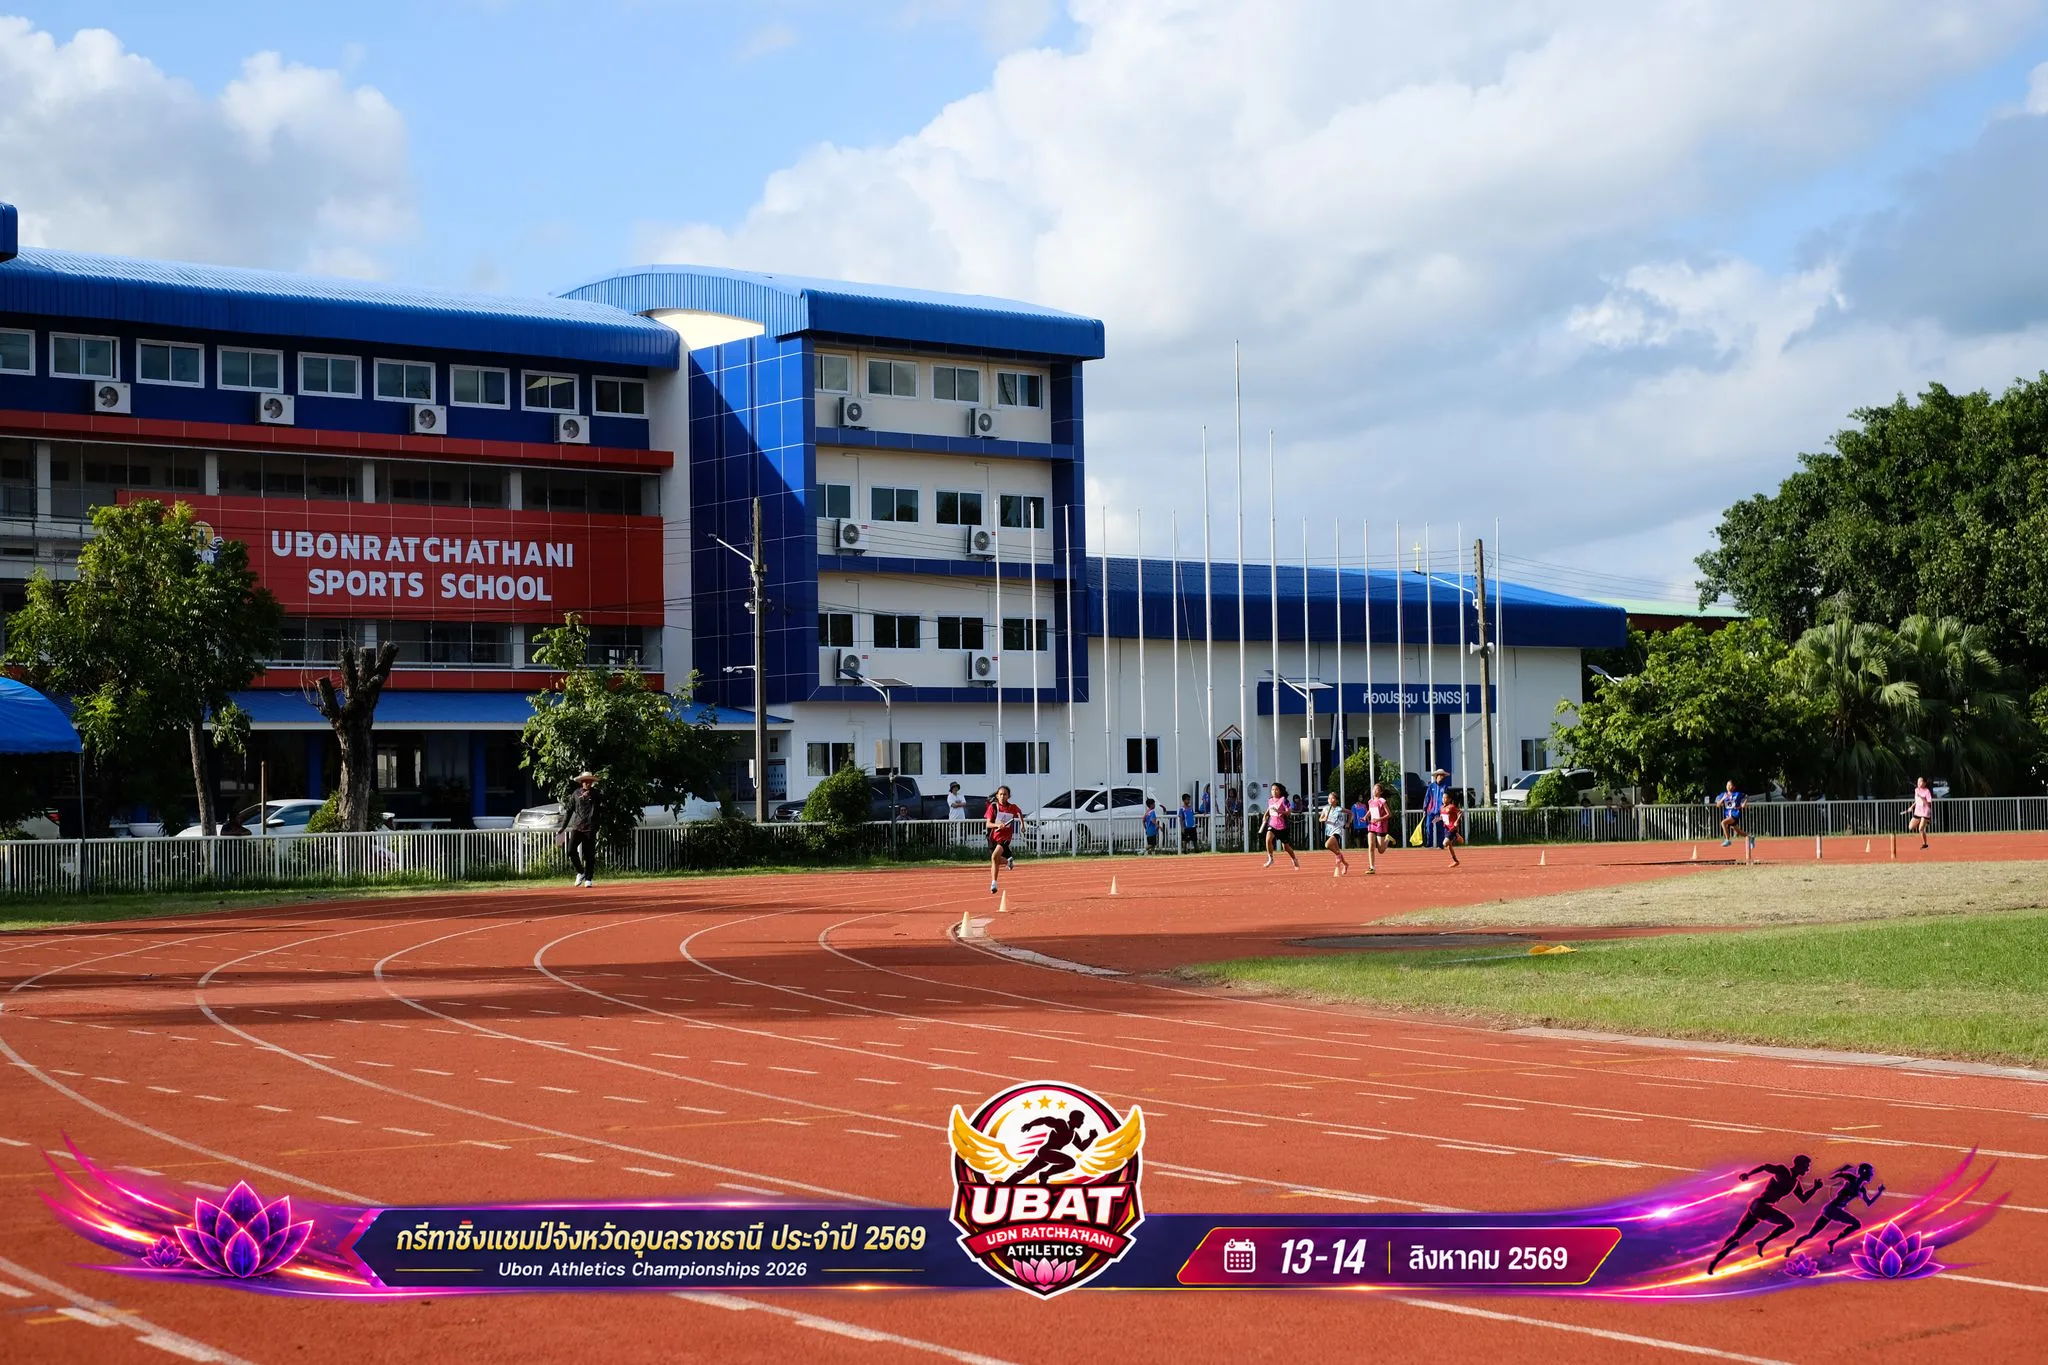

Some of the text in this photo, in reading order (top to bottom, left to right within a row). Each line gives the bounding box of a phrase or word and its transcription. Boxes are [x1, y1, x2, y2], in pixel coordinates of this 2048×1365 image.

[271, 530, 573, 568] UBONRATCHATHANI
[308, 568, 552, 602] SPORTS SCHOOL
